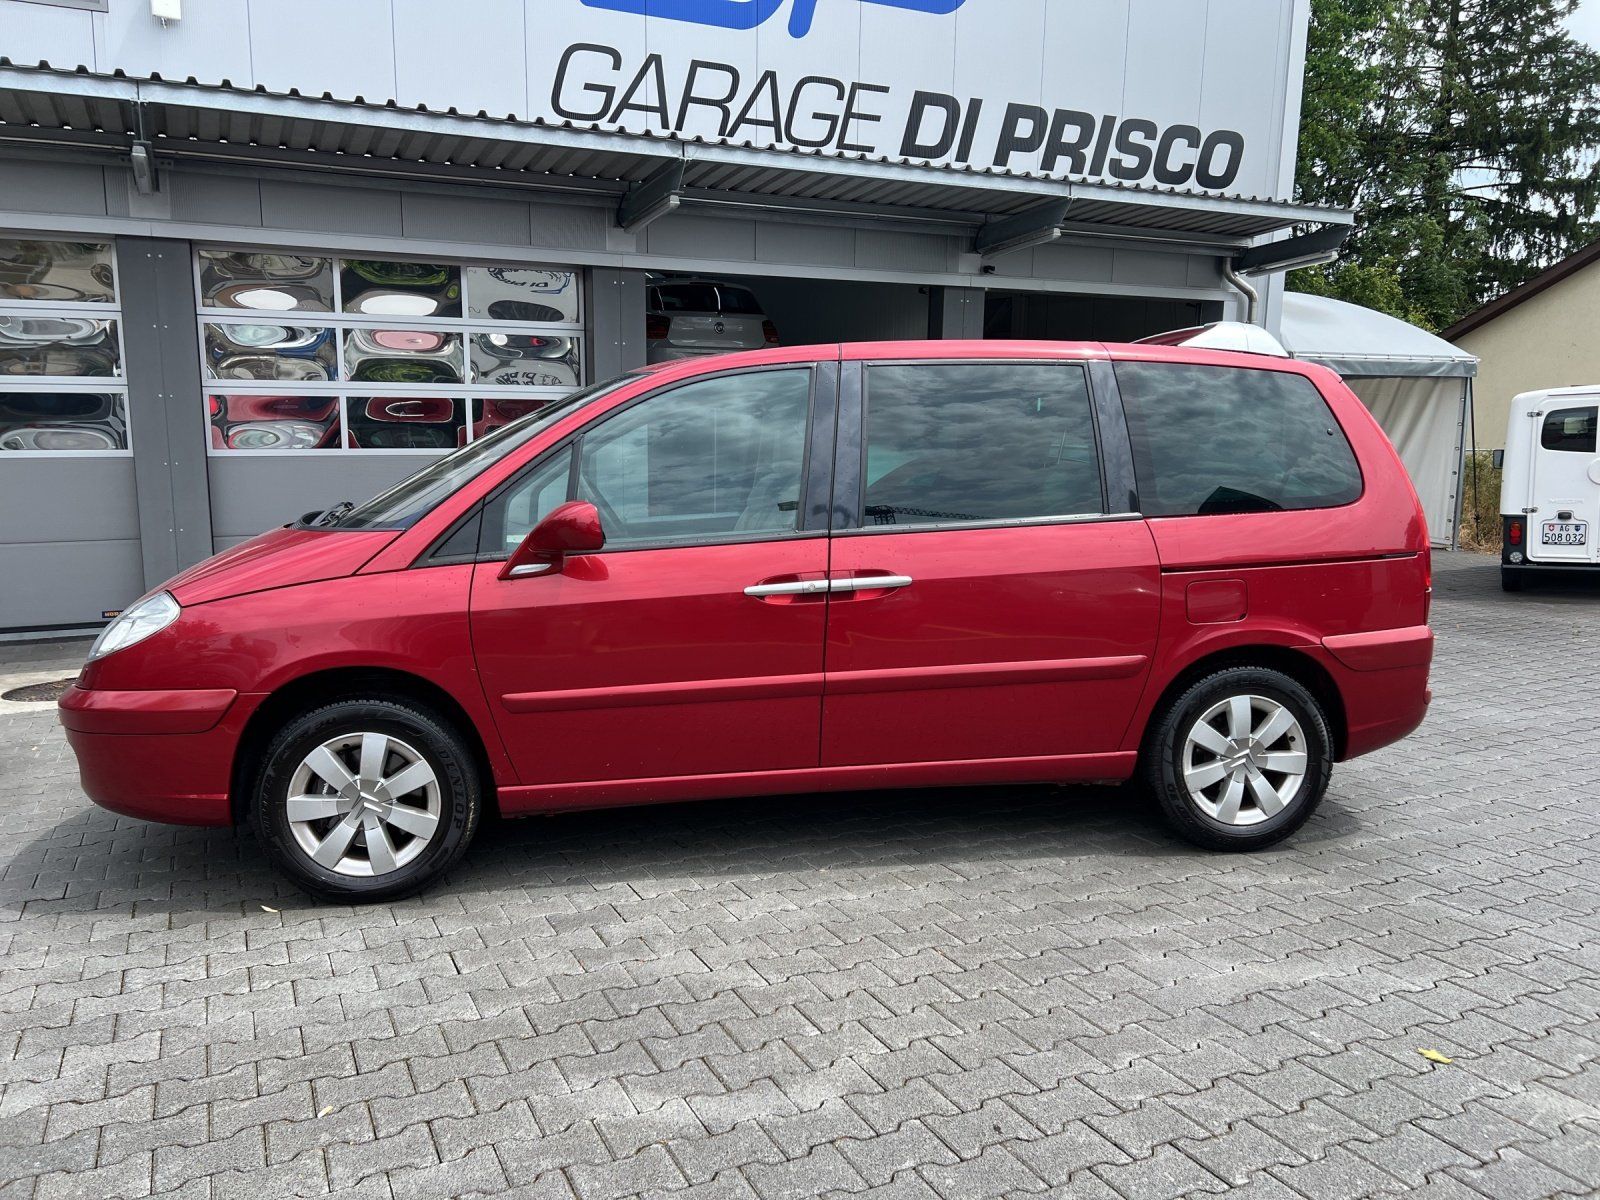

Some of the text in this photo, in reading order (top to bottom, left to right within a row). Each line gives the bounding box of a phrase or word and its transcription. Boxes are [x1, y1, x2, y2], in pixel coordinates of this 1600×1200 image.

[551, 43, 1244, 189] GARAGE DI PRISCO
[1545, 533, 1584, 543] 508 032
